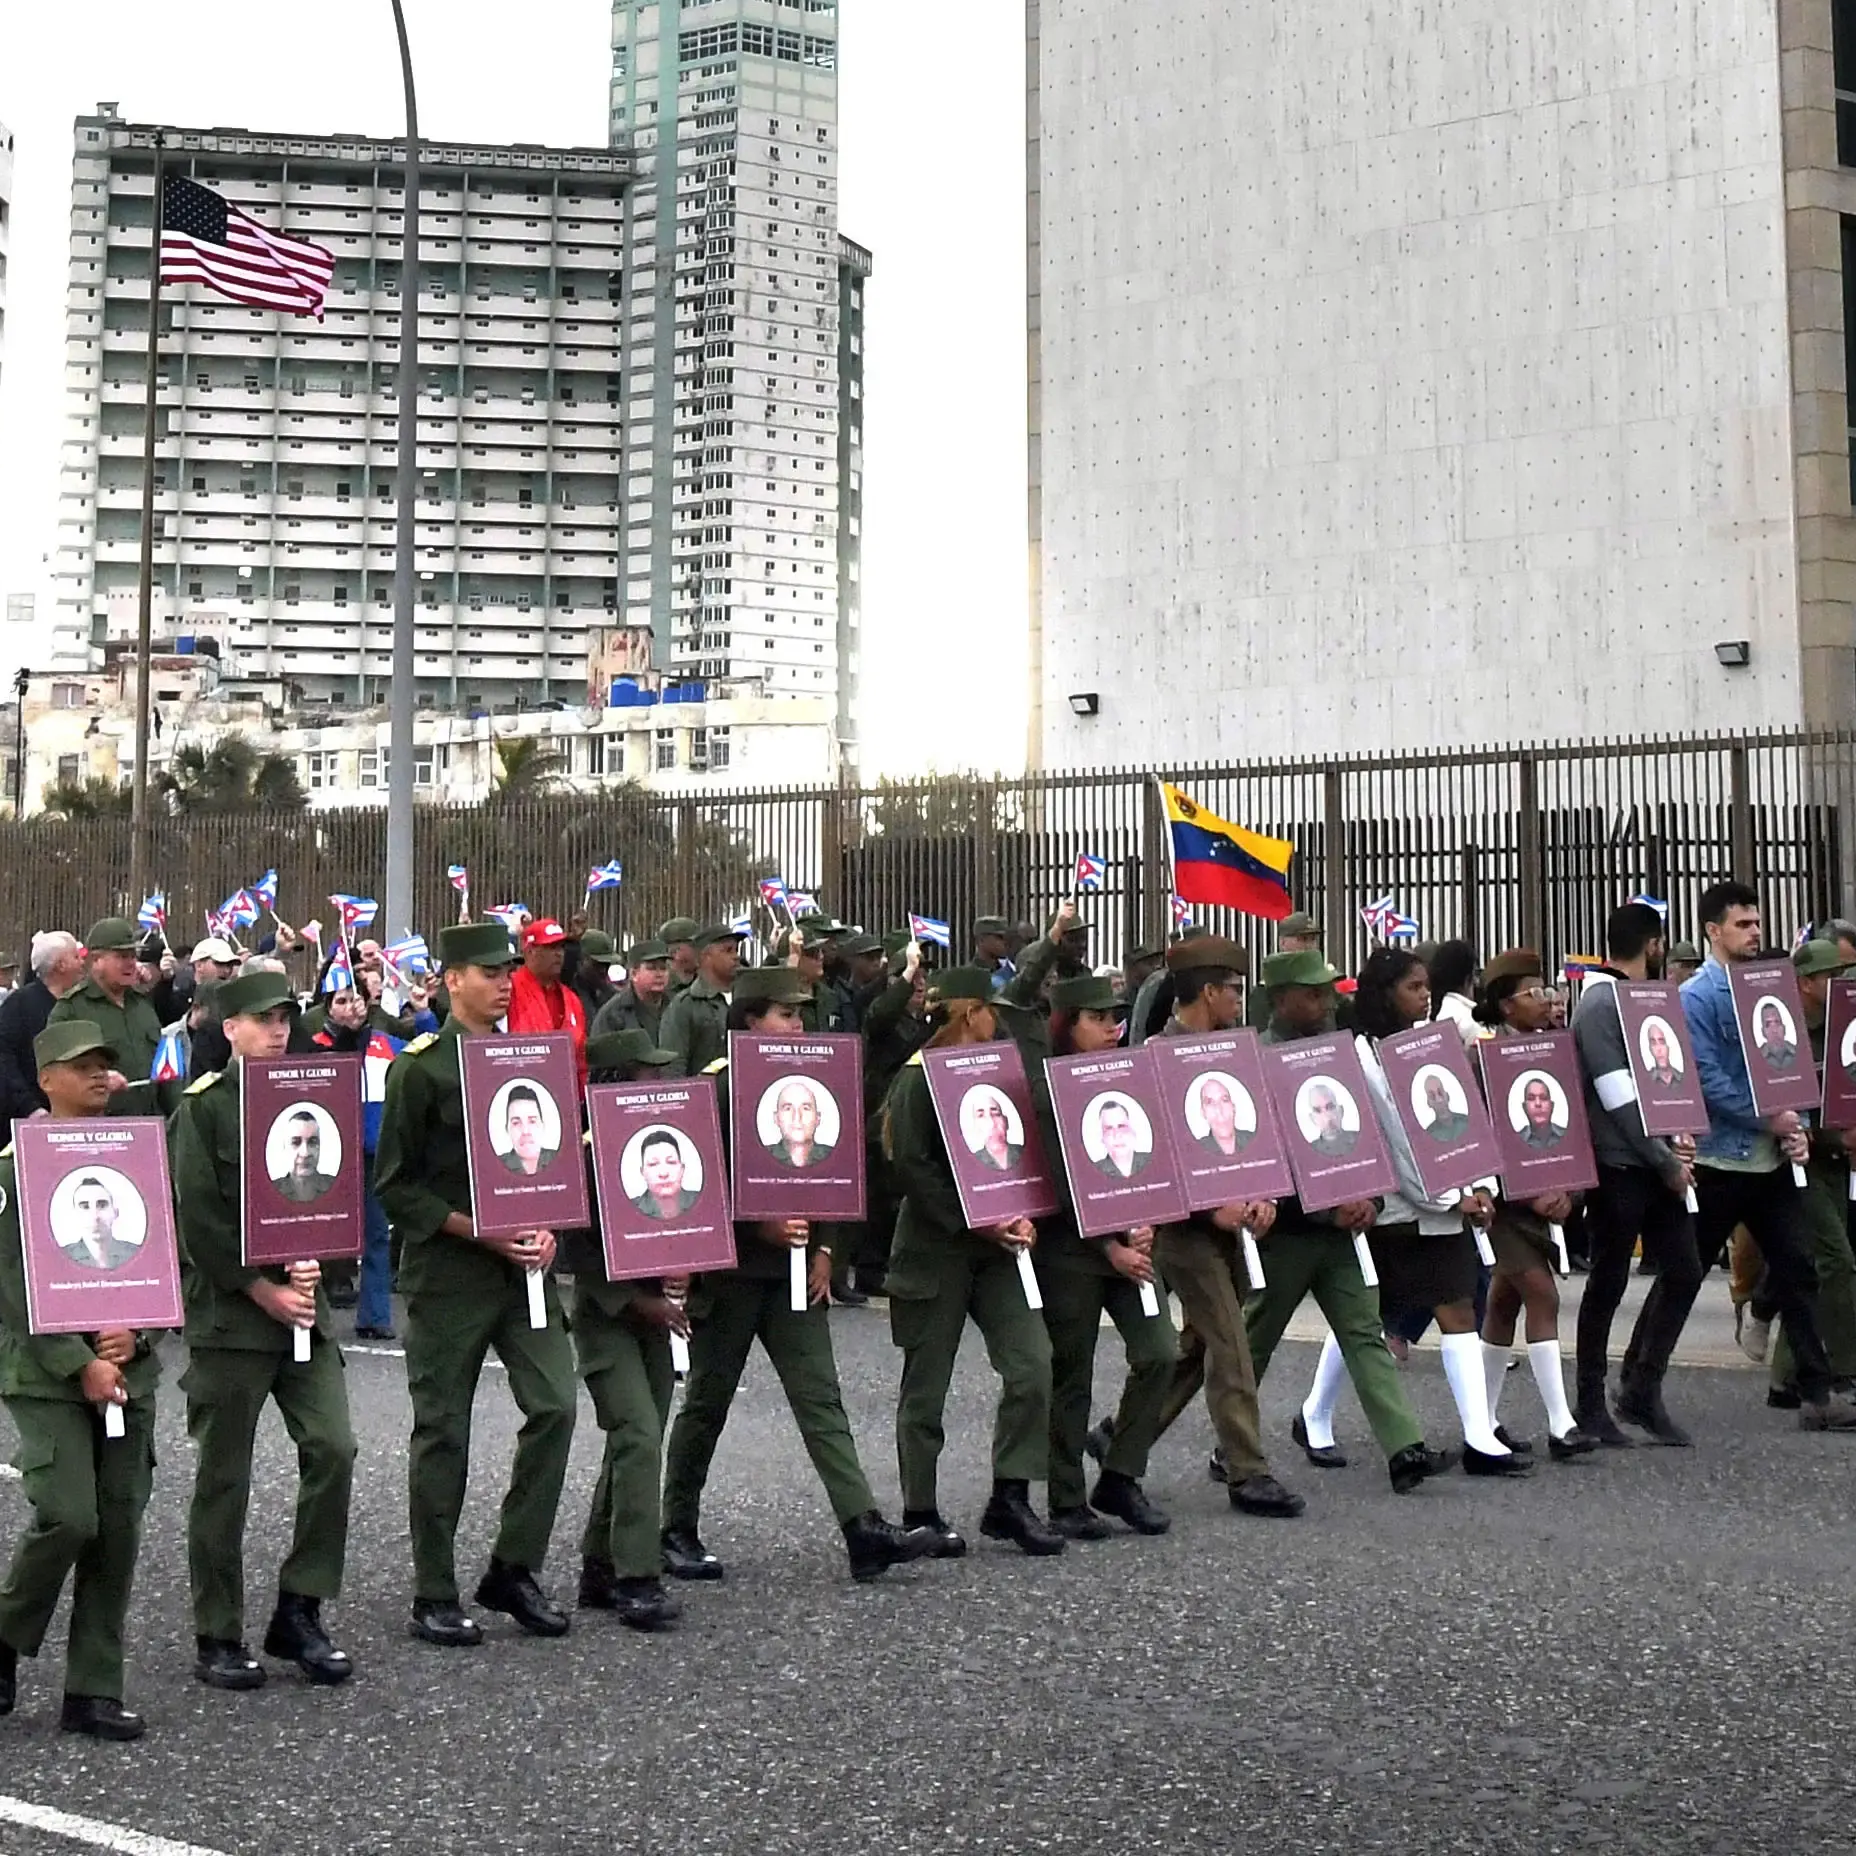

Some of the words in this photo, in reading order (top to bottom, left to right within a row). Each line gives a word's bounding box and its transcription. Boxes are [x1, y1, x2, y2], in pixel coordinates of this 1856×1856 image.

[485, 1047, 513, 1056] HONOR
[521, 1046, 550, 1054] GLORIA
[759, 1045, 792, 1053] HONOR
[800, 1046, 833, 1055] GLORIA
[1071, 1065, 1099, 1075] HONOR
[1105, 1060, 1133, 1070] GLORIA
[269, 1070, 299, 1079] HONOR
[306, 1068, 336, 1077] GLORIA
[616, 1095, 648, 1105] HONOR
[657, 1091, 689, 1102] GLORIA
[47, 1133, 85, 1142] HONOR
[95, 1132, 133, 1141] GLORIA
